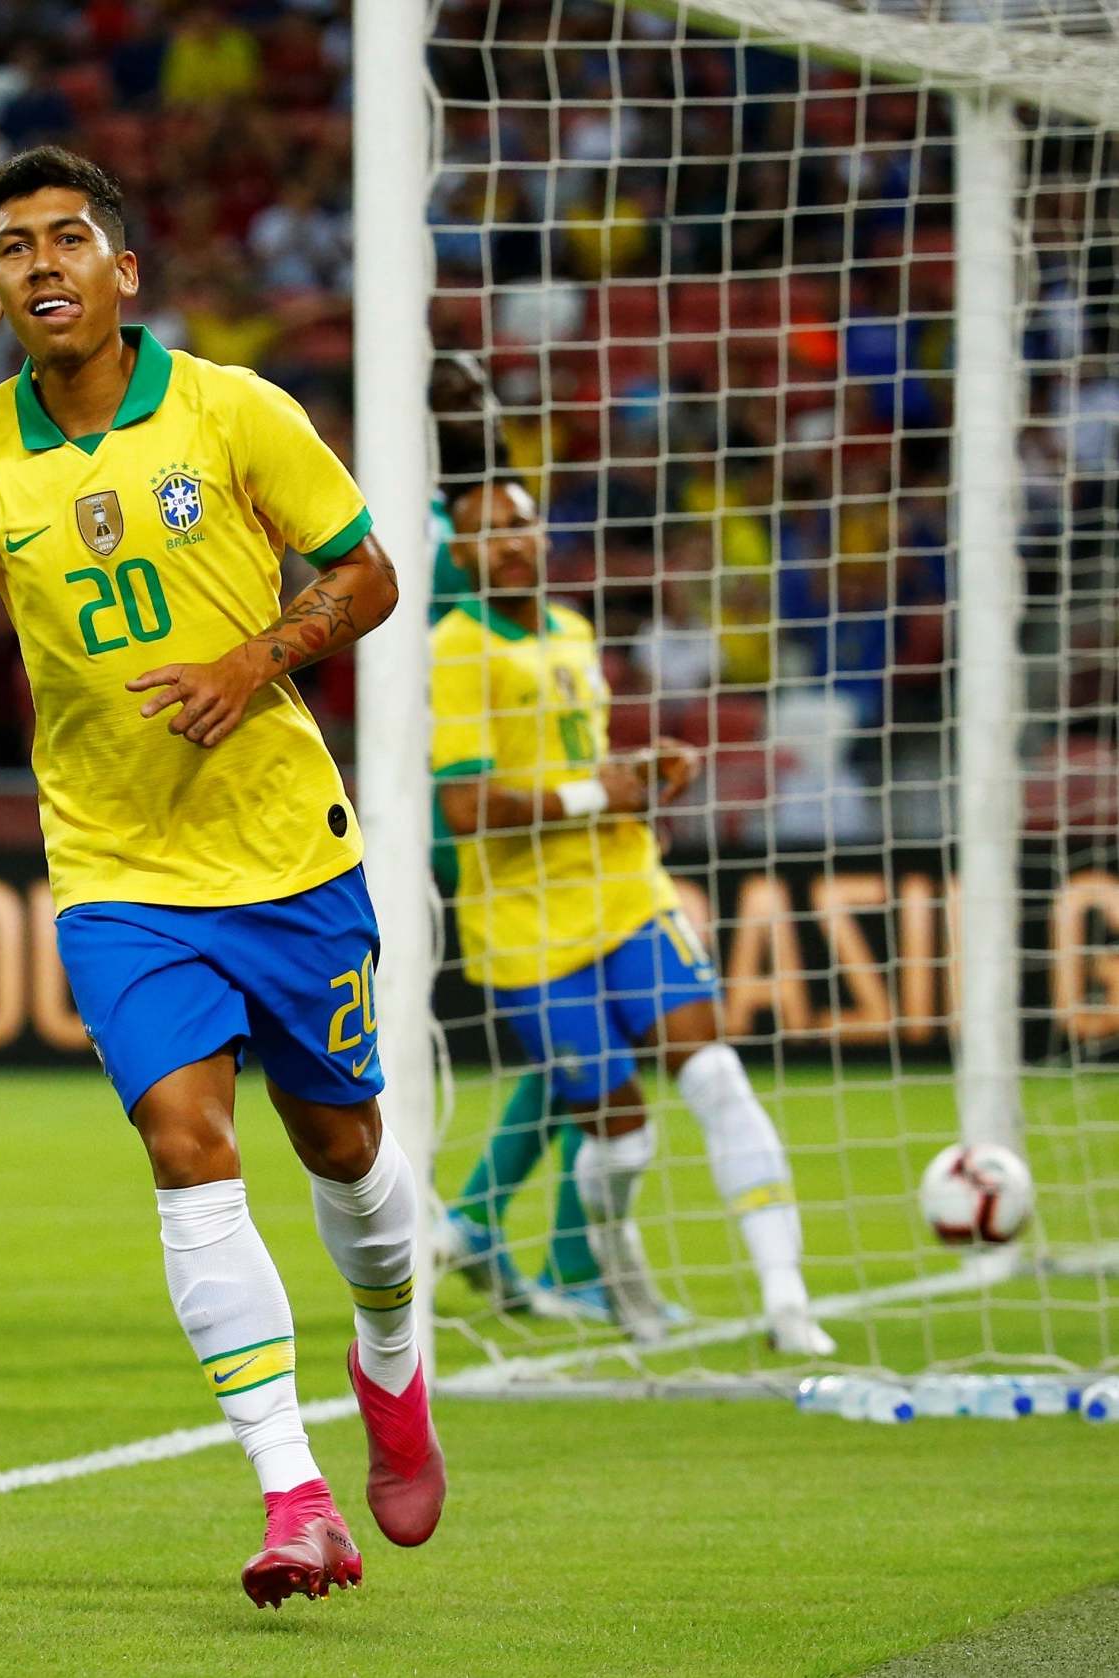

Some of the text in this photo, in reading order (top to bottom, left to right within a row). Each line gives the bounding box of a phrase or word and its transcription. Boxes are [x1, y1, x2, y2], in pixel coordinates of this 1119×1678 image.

[172, 496, 189, 507] CBF
[166, 532, 206, 550] BRASIL
[65, 558, 172, 656] 20
[327, 950, 377, 1053] 20
